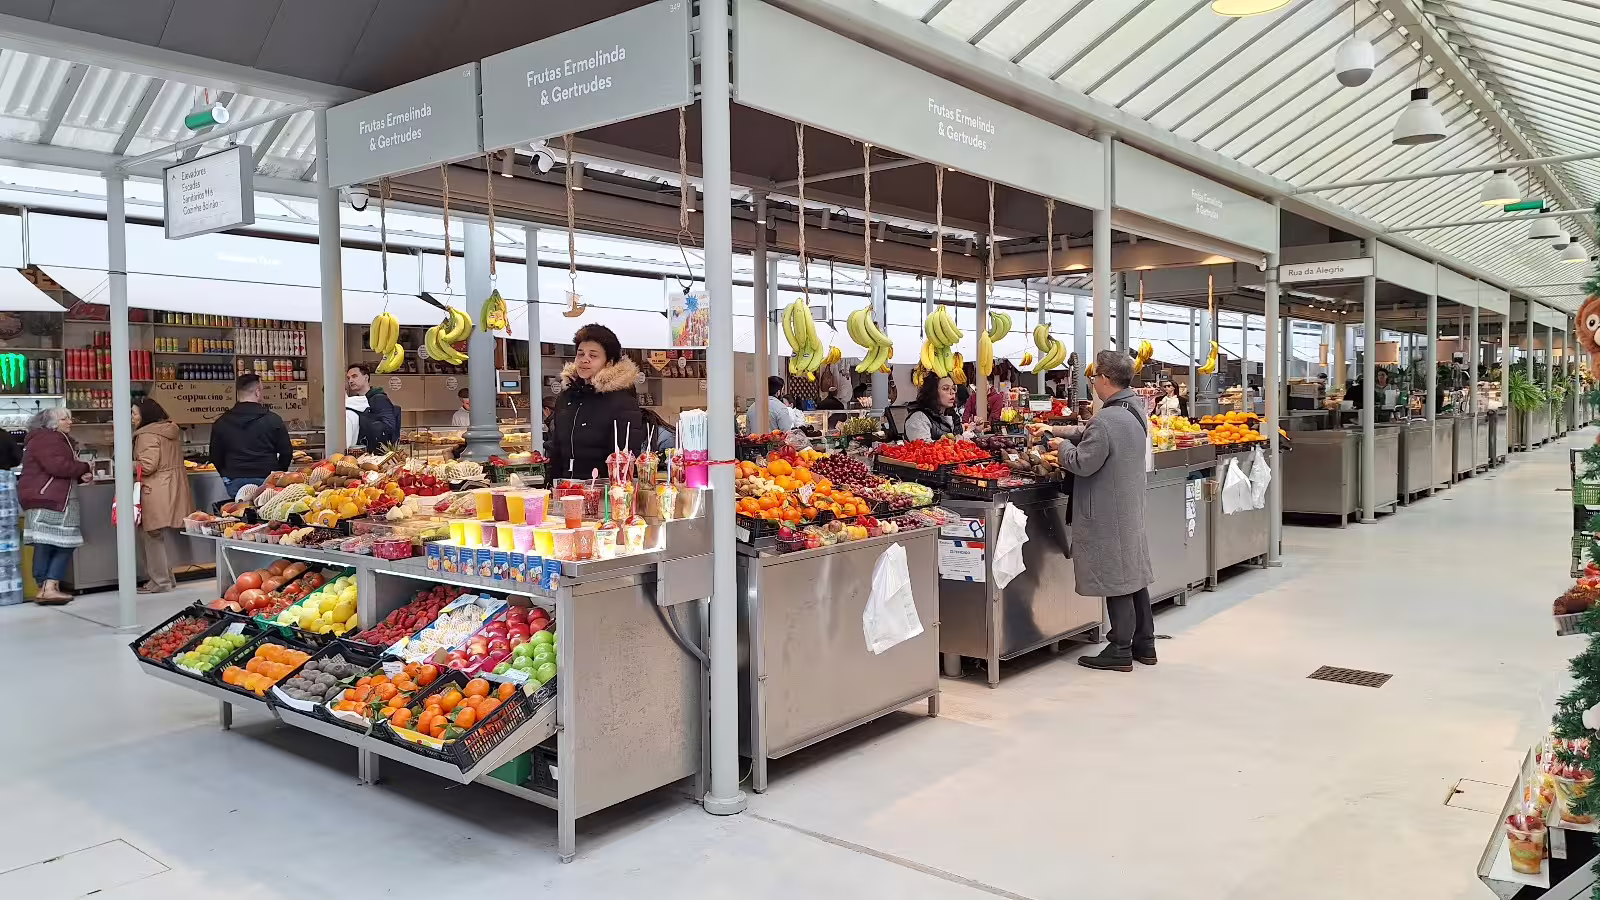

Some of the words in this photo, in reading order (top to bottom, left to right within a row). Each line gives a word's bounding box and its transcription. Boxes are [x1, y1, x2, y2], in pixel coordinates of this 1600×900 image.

[526, 67, 562, 88] Frutas
[564, 44, 626, 77] Ermelinda
[540, 89, 550, 106] &
[551, 75, 612, 103] Gertrudes
[359, 118, 385, 135] Frutas
[386, 103, 432, 127] Ermelinda
[928, 97, 955, 120] Frutas
[955, 108, 995, 135] Ermelinda
[369, 137, 377, 151] &
[378, 127, 422, 149] Gertrudes
[938, 121, 945, 137] &
[946, 125, 987, 150] Gertrudes
[182, 168, 207, 181] Elevadores
[1288, 269, 1303, 277] Rua
[1304, 267, 1314, 275] da
[1316, 265, 1344, 275] Alegria
